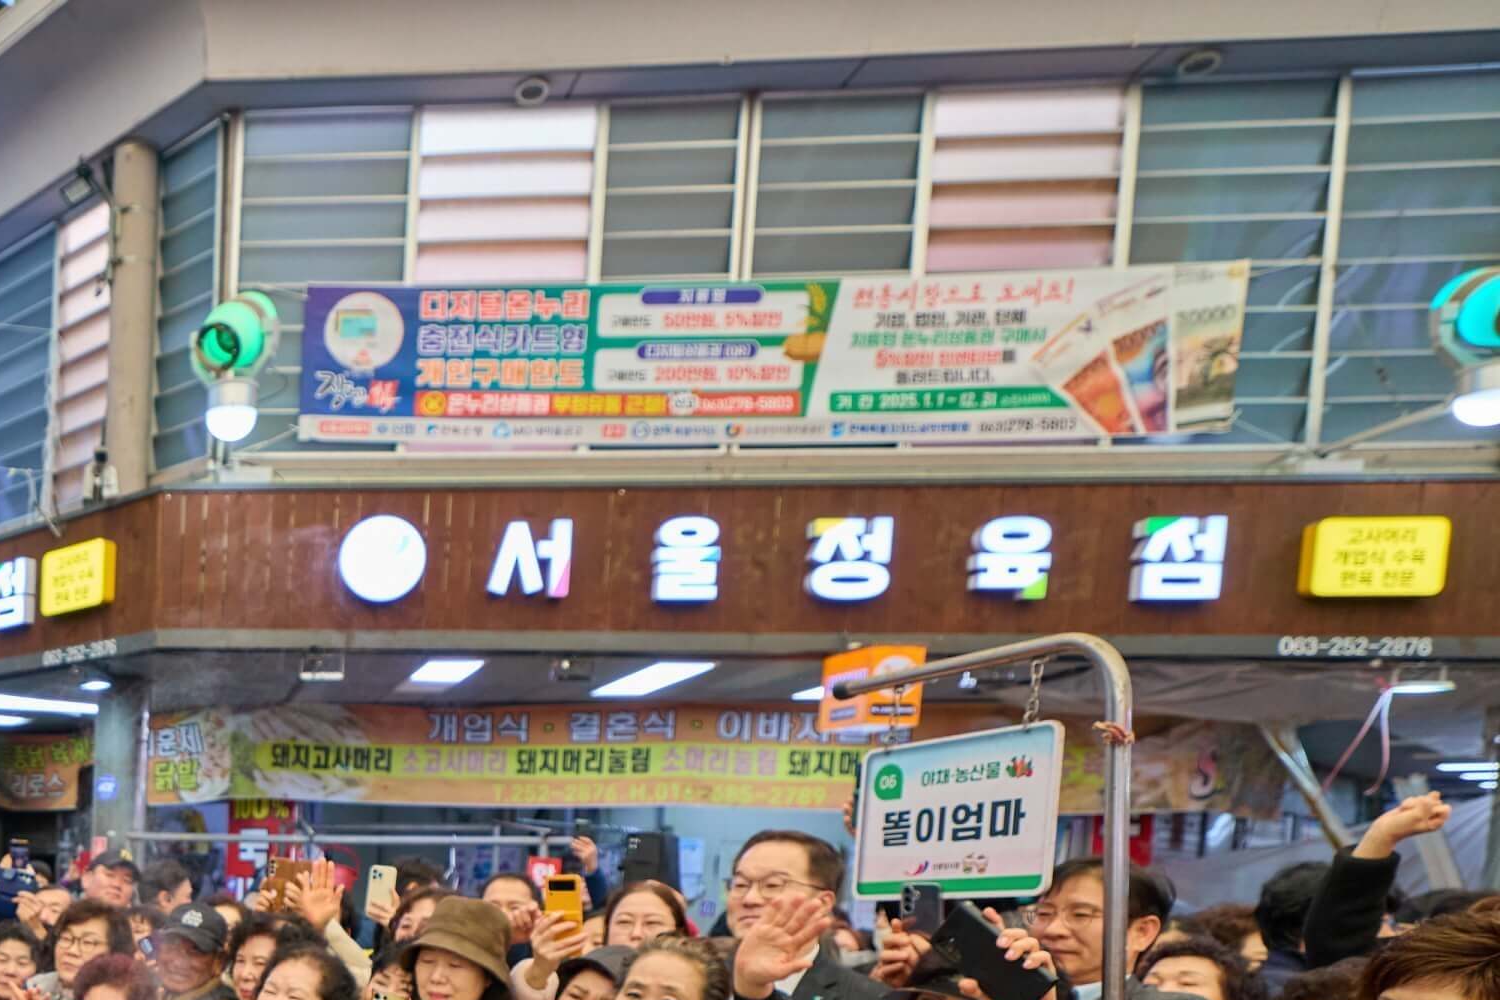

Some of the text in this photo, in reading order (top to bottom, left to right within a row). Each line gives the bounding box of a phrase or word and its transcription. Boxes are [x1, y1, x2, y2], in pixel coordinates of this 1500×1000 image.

[419, 290, 591, 320] 디지털온누리
[852, 277, 1077, 310] 전통시장으로 오세요!
[662, 311, 720, 328] 50만원,
[724, 311, 784, 328] 5%할인
[874, 309, 1028, 328] 기업, 법인, 기관, 단체
[417, 324, 589, 354] 충전식카드형
[901, 329, 996, 347] 온누리상품권
[415, 358, 586, 388] 개인구매한도
[448, 394, 551, 416] 온누리상품권
[487, 514, 1229, 603] 서울정육점
[1278, 635, 1434, 657] 063-252-2876
[148, 723, 204, 758] 훈제
[429, 711, 531, 745] 개업식
[568, 709, 677, 743] 결혼식
[270, 743, 861, 777] 돼지고사머리 소고사머리 돼지머리눌림 소머리눌림 돼지머
[154, 759, 201, 792] 닭발
[881, 797, 1027, 848] 똘이엄마
